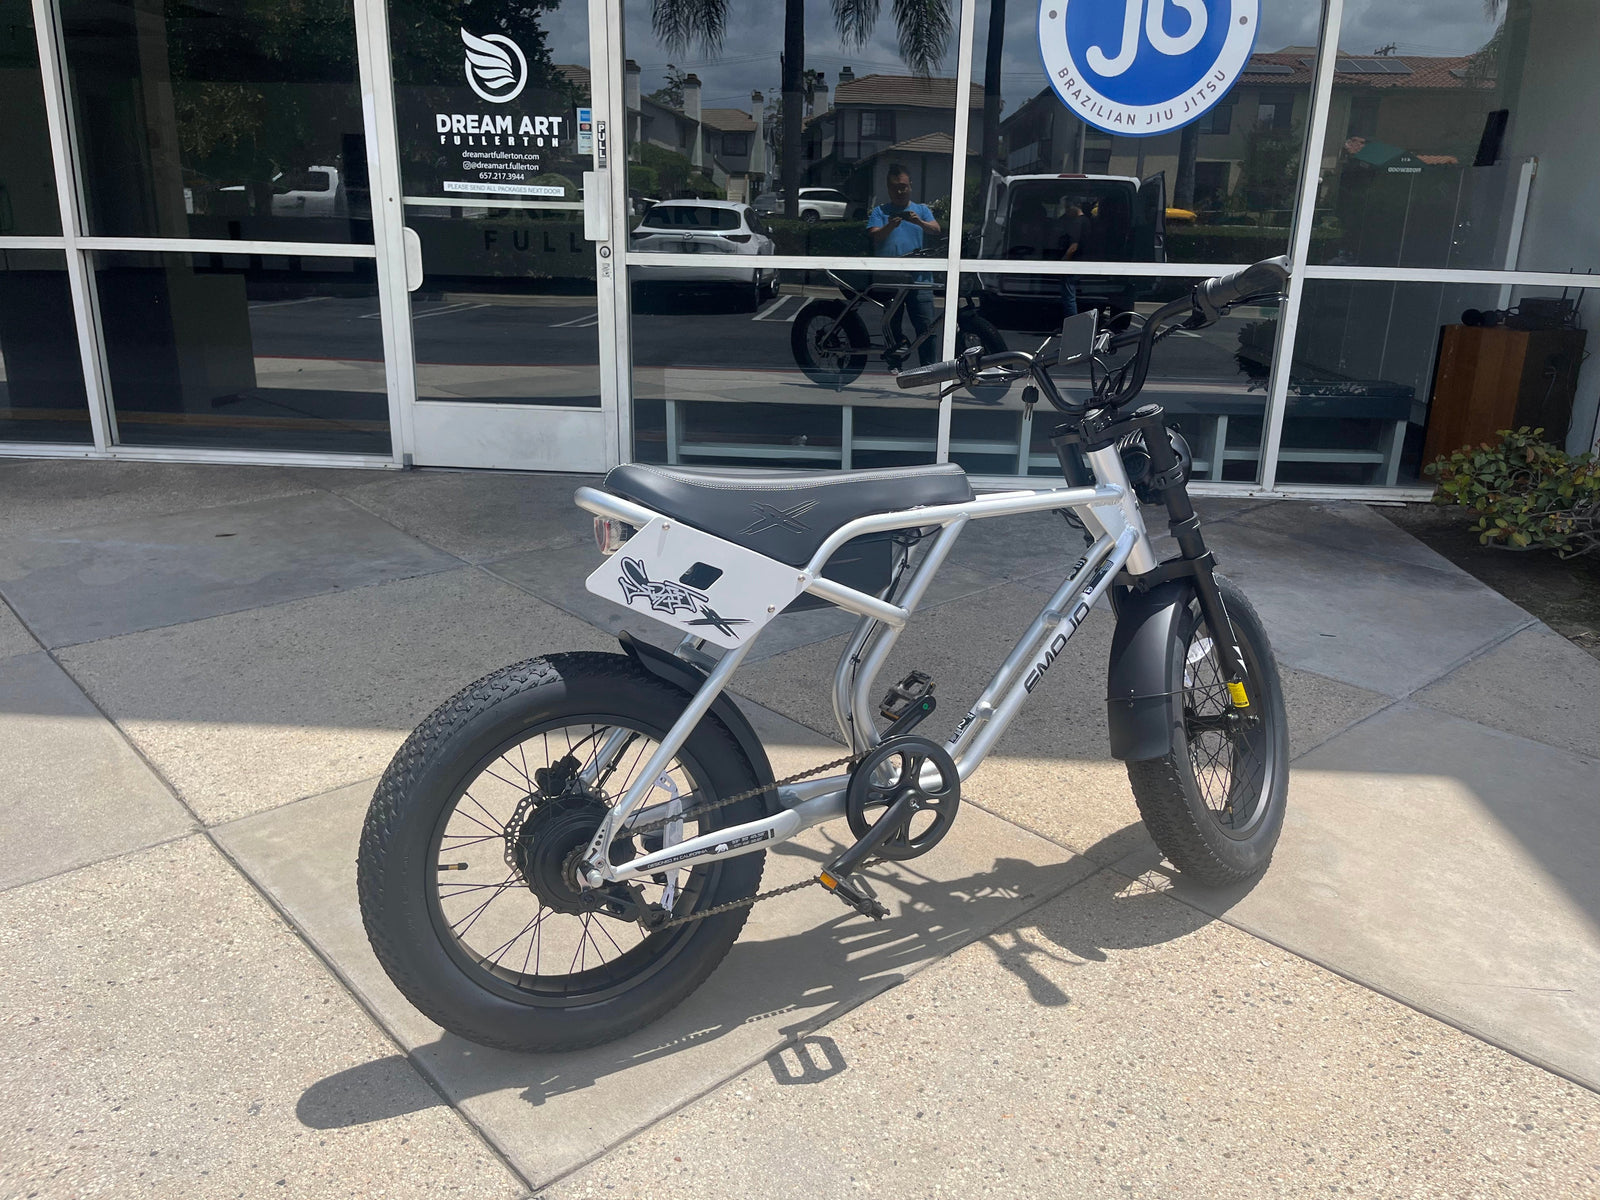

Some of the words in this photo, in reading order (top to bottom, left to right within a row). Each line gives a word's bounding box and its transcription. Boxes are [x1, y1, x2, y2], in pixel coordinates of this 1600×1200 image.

[1058, 67, 1136, 125] BRAZILIAN
[1146, 108, 1173, 125] JIU
[1184, 69, 1226, 113] JITSU
[436, 114, 513, 134] DREAM
[519, 115, 562, 135] ART
[440, 135, 559, 147] FULLERTON
[598, 124, 606, 158] PULL
[462, 150, 540, 160] dreamartfullerton.com
[471, 161, 539, 171] @dreamart.fullerton
[479, 172, 525, 181] 657.217.3944
[447, 183, 468, 191] PLEASE
[498, 185, 527, 193] PACKAGES
[1024, 602, 1090, 694] EMOJO
